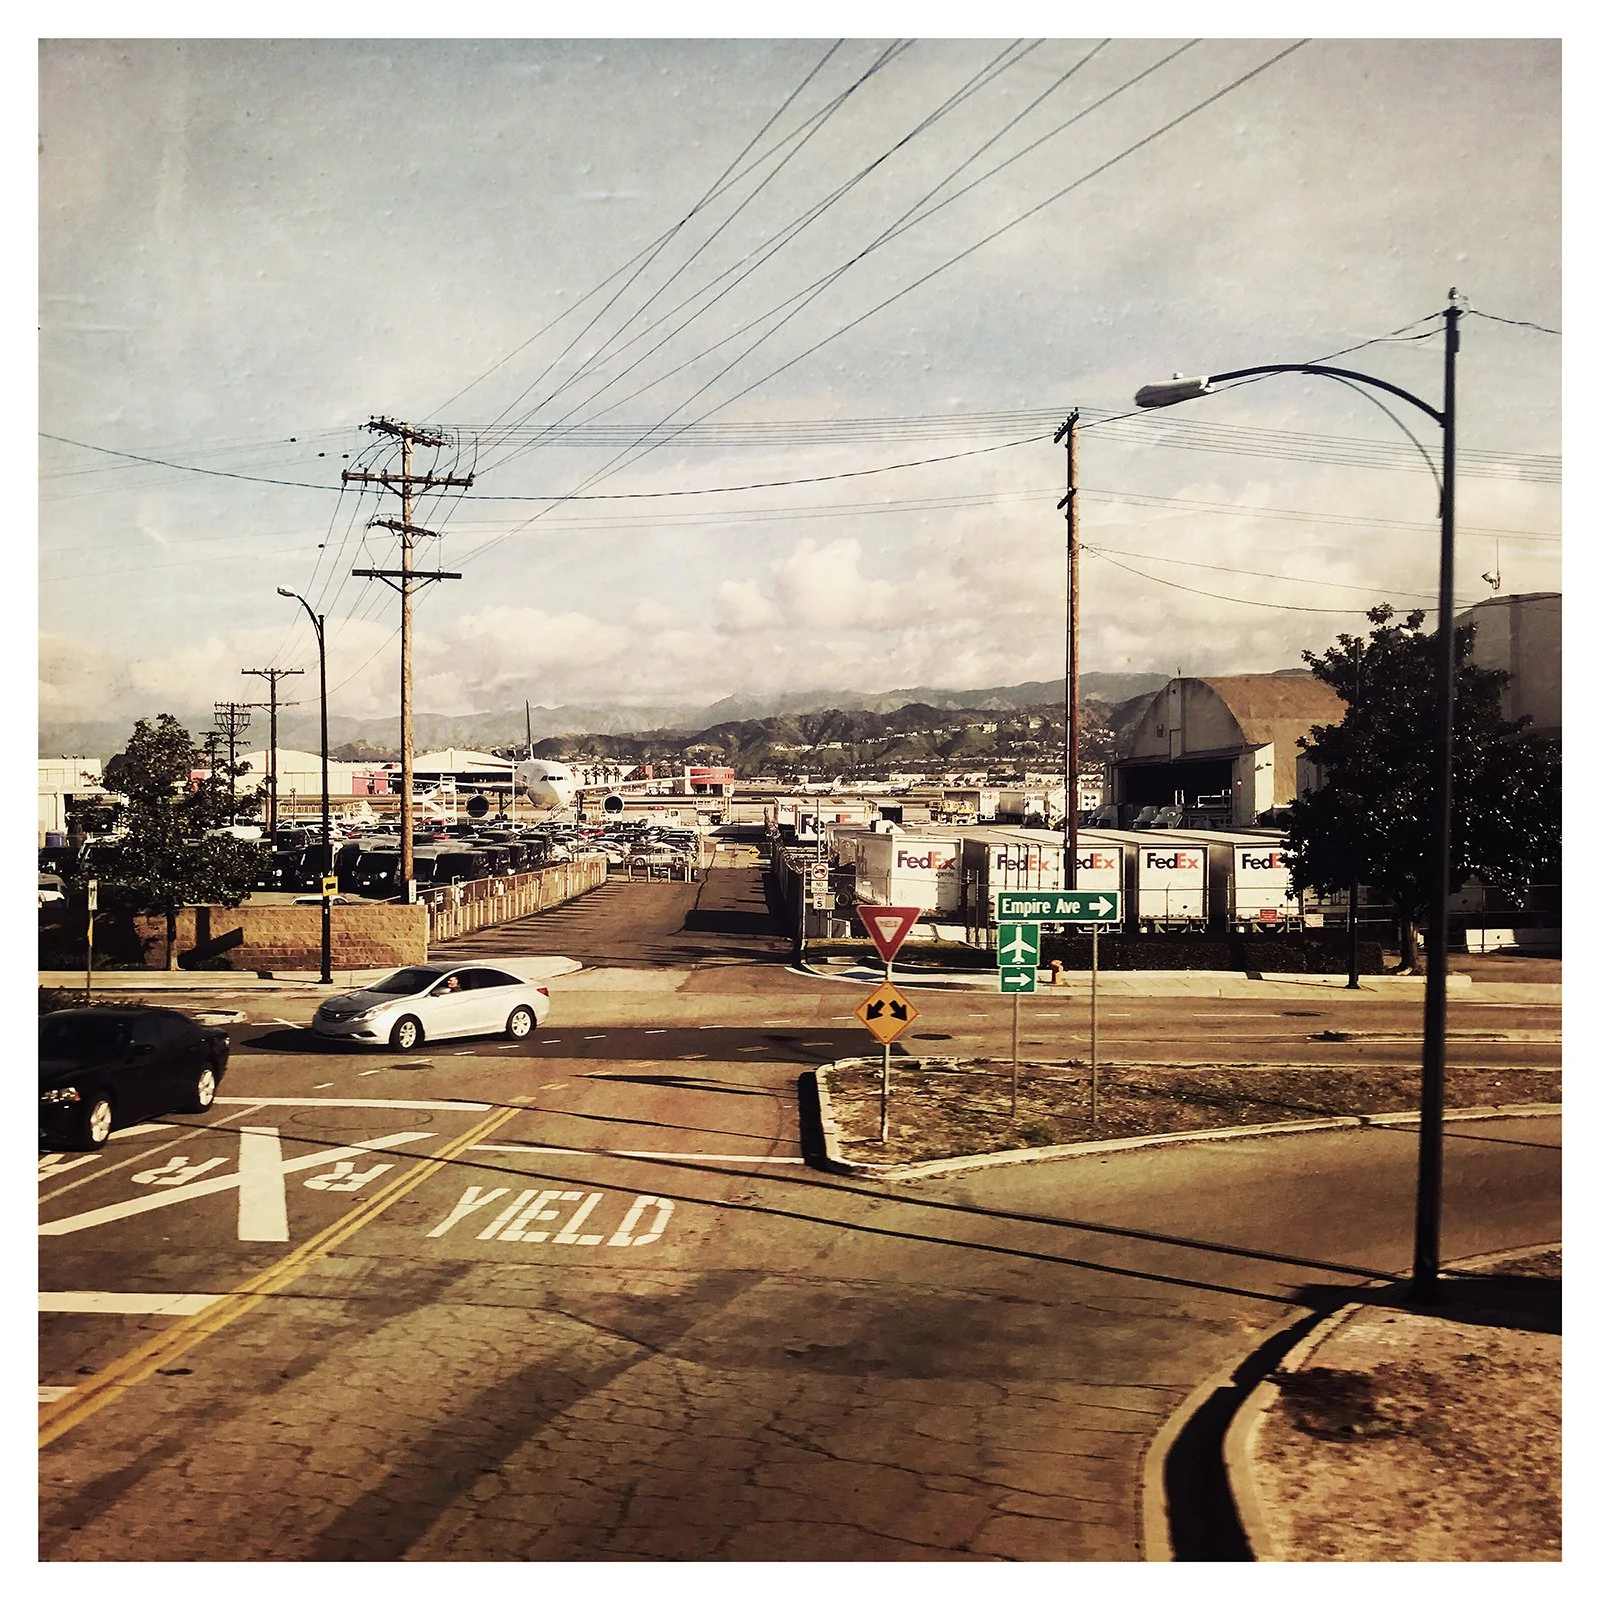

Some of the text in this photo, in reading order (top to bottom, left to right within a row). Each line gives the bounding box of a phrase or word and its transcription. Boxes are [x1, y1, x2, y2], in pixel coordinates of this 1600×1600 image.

[898, 850, 957, 869] FedEx
[997, 854, 1050, 871] FedEx
[1063, 853, 1115, 870] edEx
[1146, 853, 1199, 869] FedEx
[1241, 853, 1285, 869] FedE
[1001, 898, 1081, 917] Empire Ave
[426, 1186, 676, 1247] YIELD
